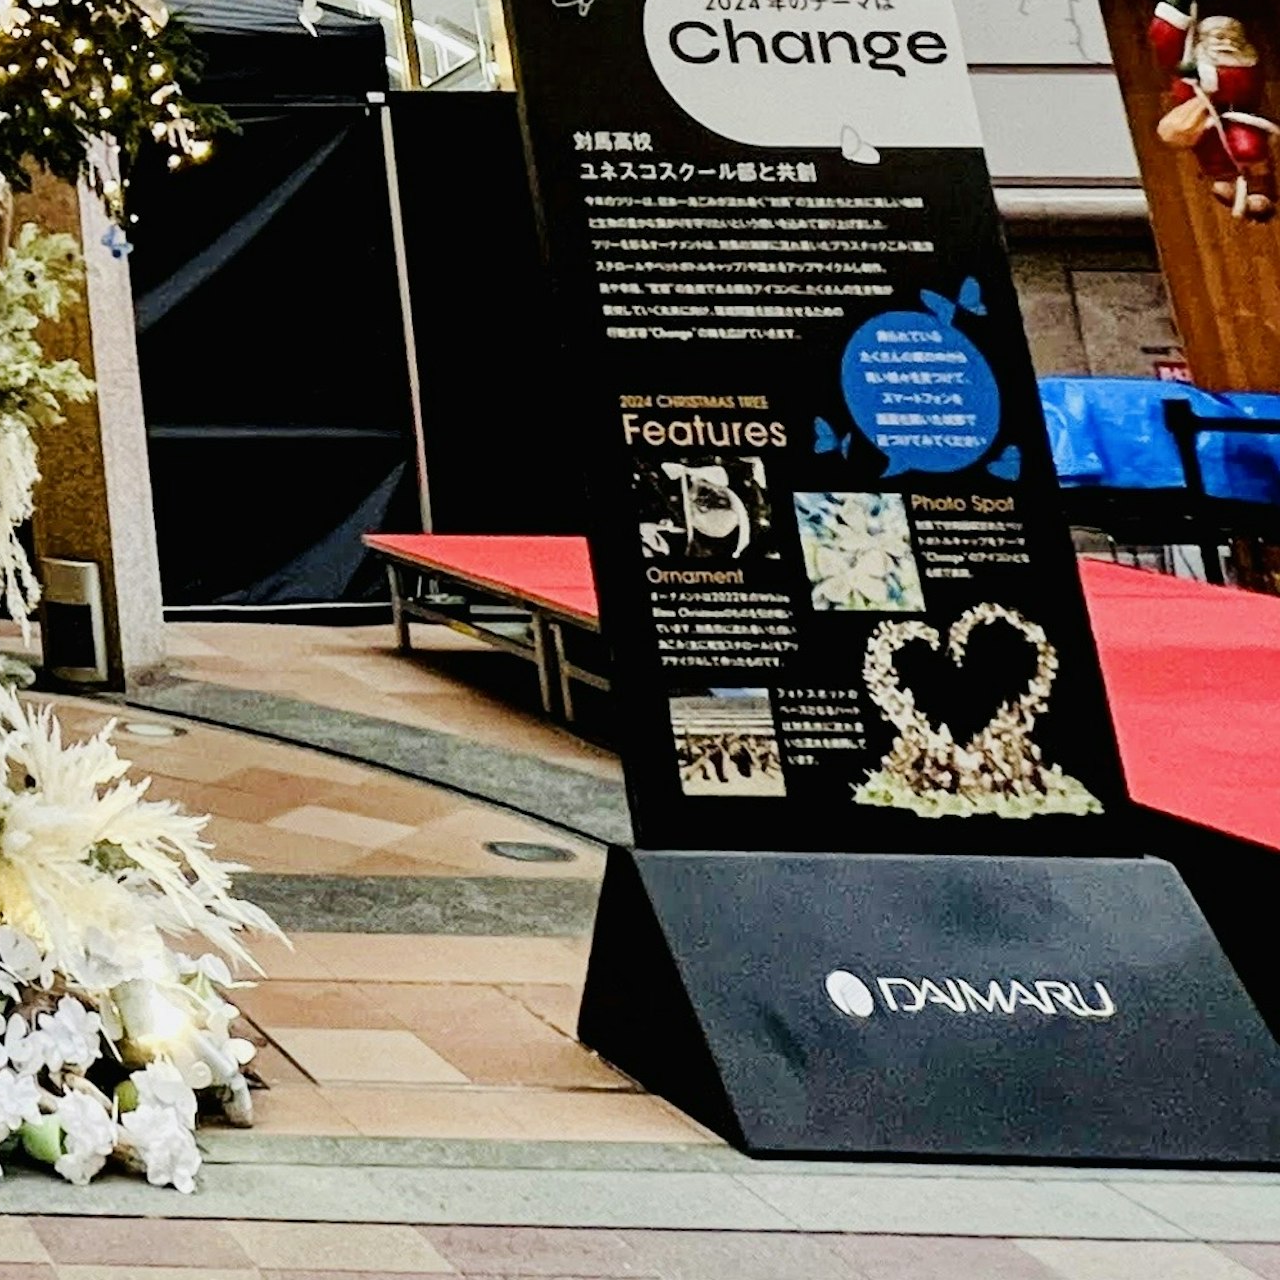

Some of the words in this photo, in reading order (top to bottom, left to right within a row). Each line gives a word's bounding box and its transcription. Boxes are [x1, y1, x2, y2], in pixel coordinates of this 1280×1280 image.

[668, 18, 948, 78] Change
[572, 130, 654, 152] 対馬高校
[579, 160, 818, 183] ユネスコスクール部と共創
[618, 394, 653, 409] 2024
[655, 394, 736, 409] CHRISTMAS
[737, 395, 770, 410] TREE
[621, 412, 788, 448] Features
[910, 493, 967, 512] Photo
[971, 493, 1016, 515] Spot
[645, 565, 745, 585] Ornament
[875, 976, 1117, 1017] DAIMARU
